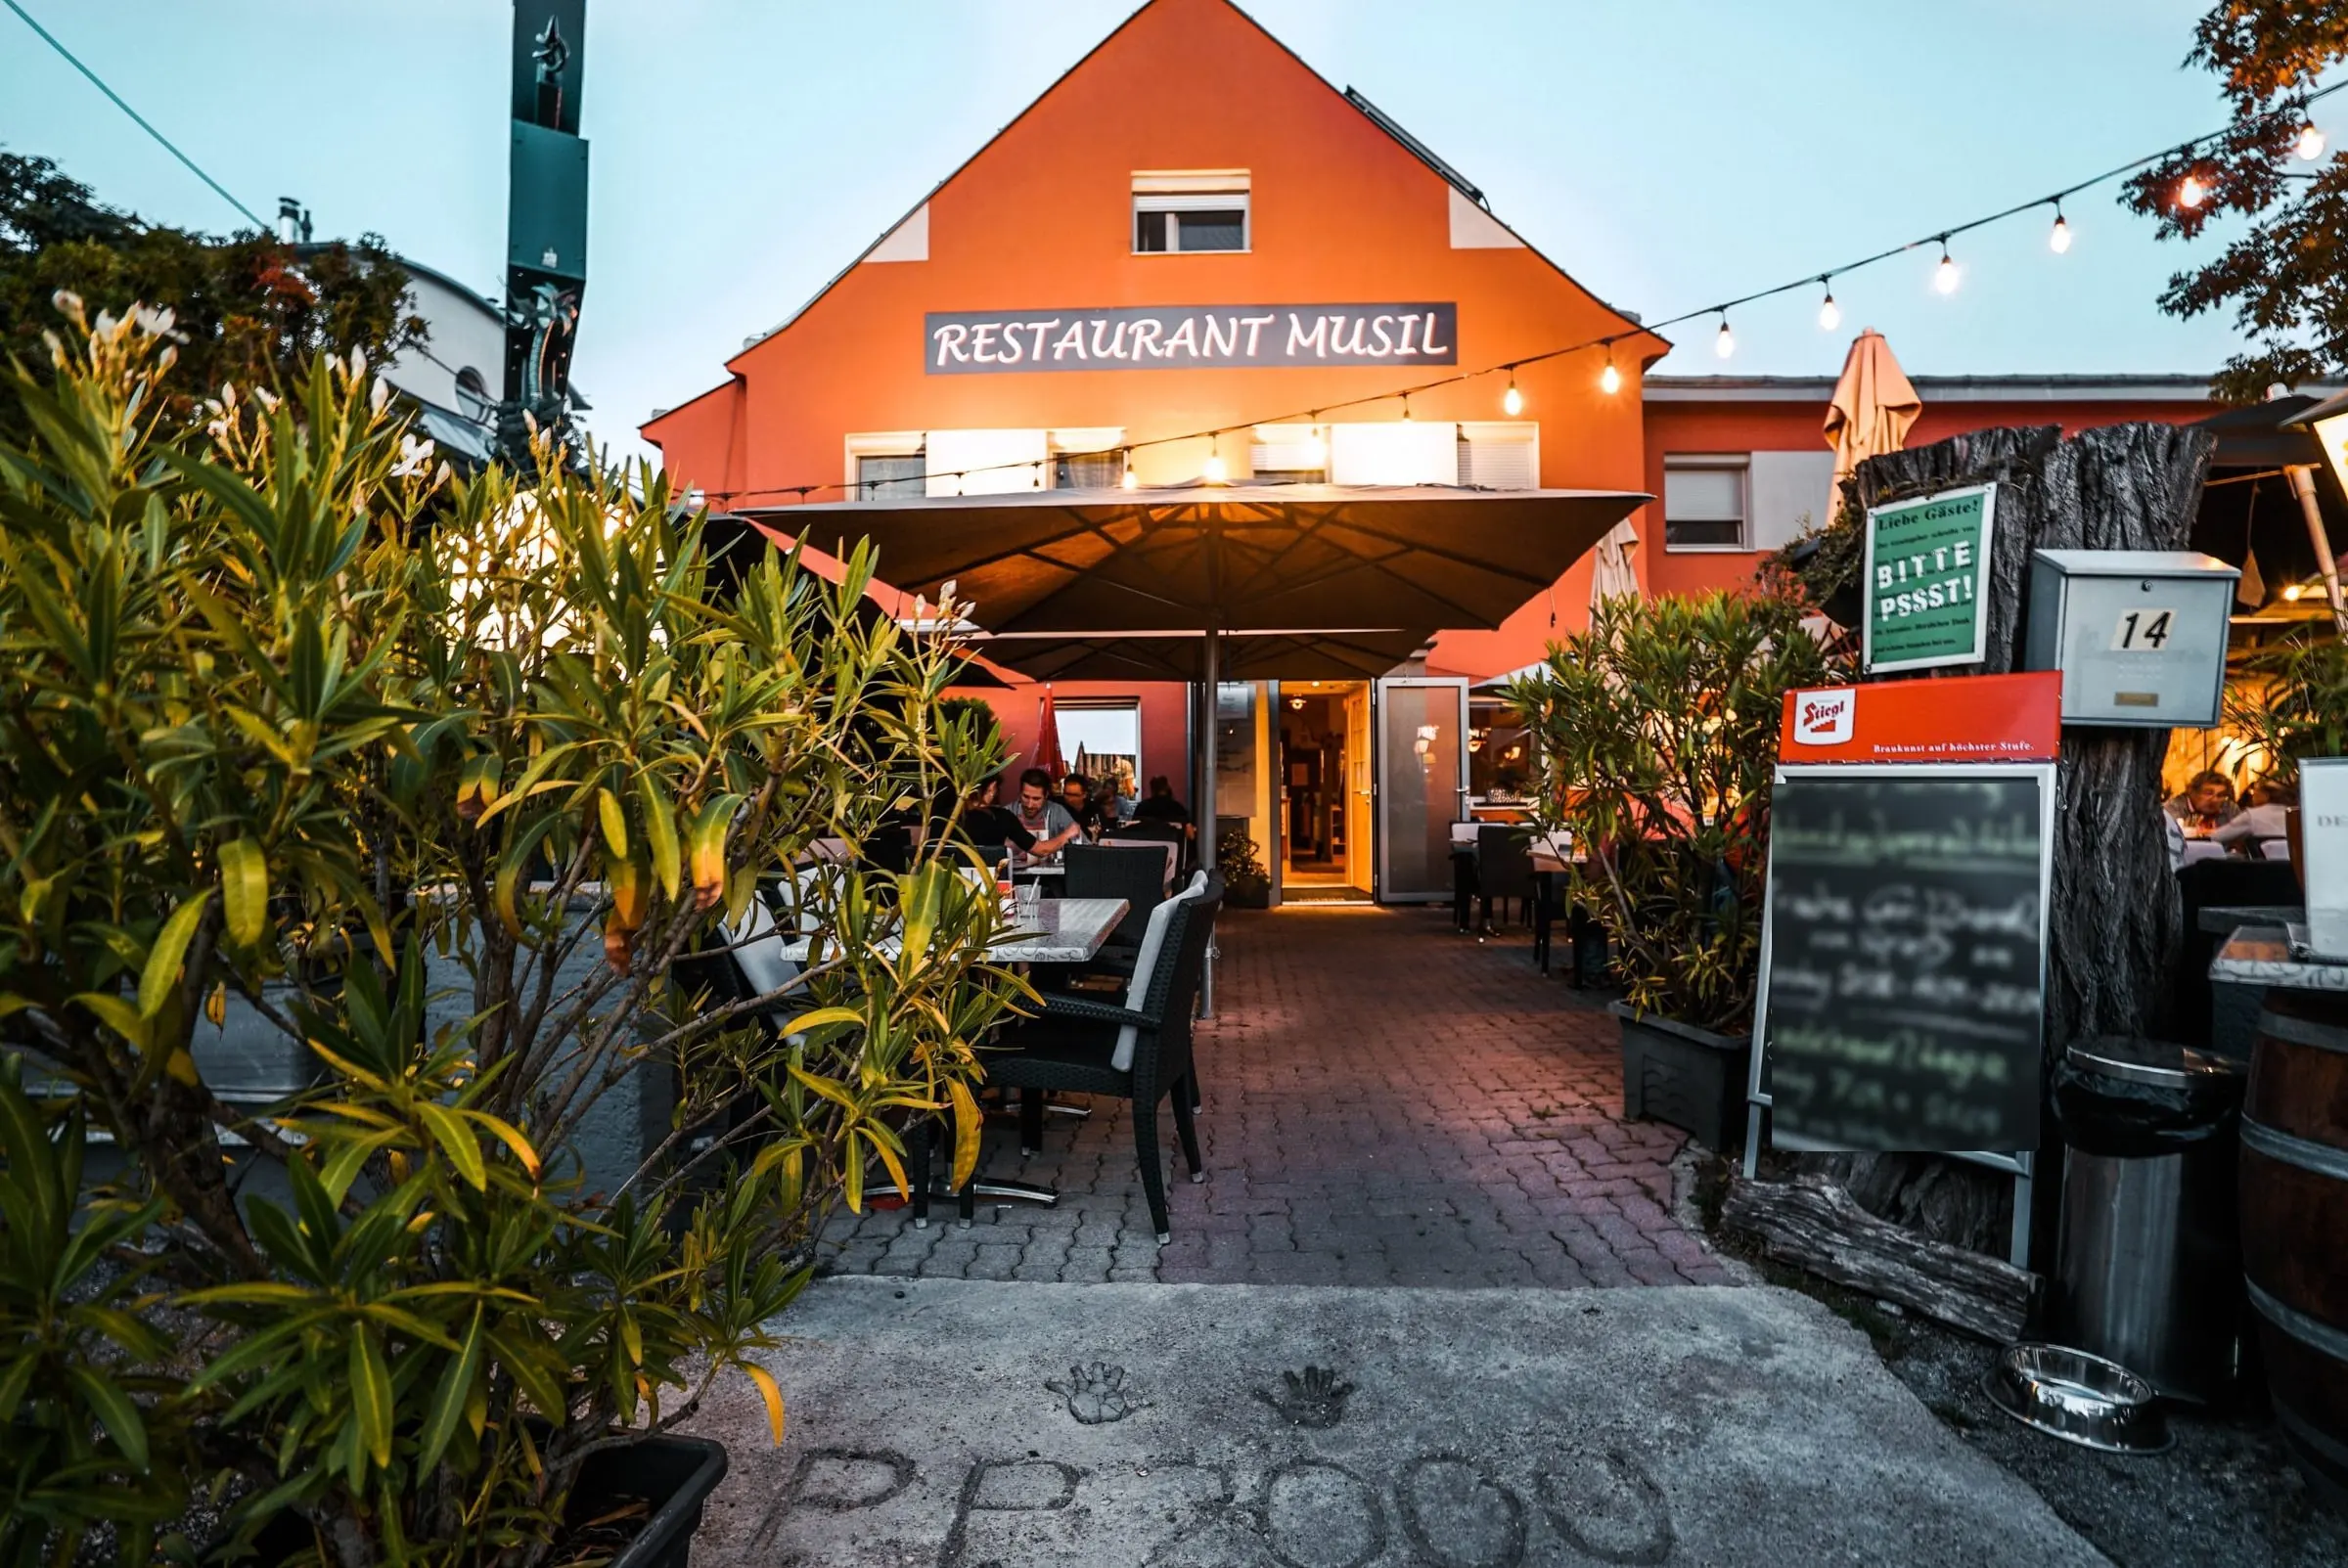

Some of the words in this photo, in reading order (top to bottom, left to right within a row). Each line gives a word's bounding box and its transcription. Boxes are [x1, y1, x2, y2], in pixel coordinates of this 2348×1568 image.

[932, 313, 1276, 366] RESTAURANT
[1286, 311, 1449, 358] MUSIL
[1878, 514, 1919, 531] Liebe
[1924, 499, 1979, 521] Gäste!
[1876, 540, 1972, 589] BITTE
[1880, 574, 1973, 622] PSSST!
[2121, 610, 2172, 650] 14
[1803, 700, 1845, 727] Stiegl
[1874, 742, 1925, 753] Braukunst
[1928, 742, 1948, 753] auf
[1949, 741, 1997, 752] höchster
